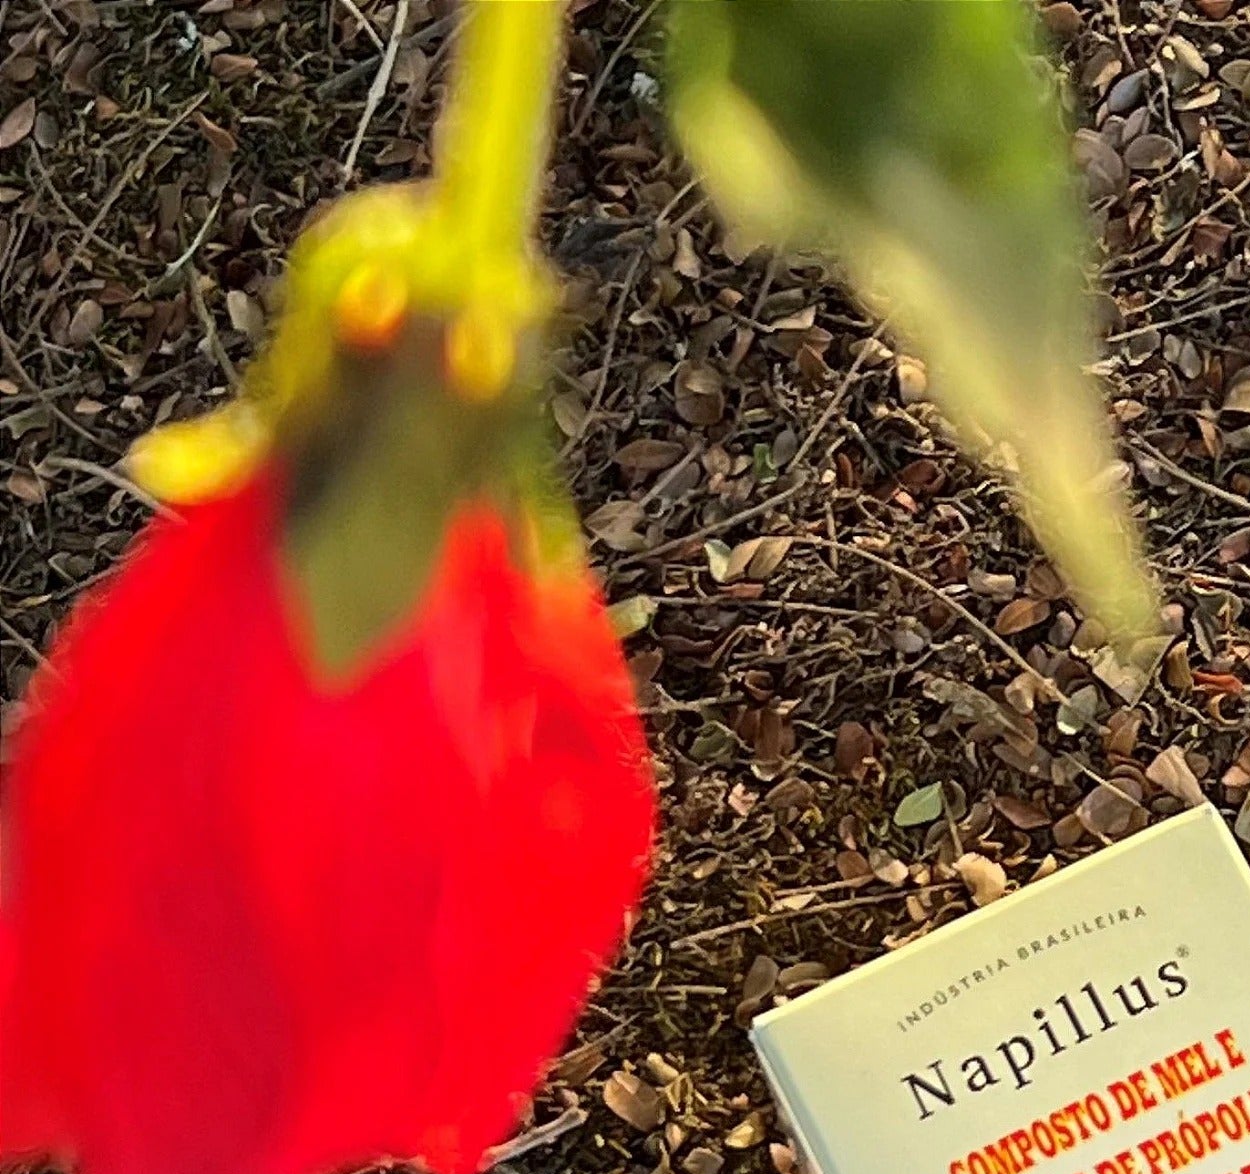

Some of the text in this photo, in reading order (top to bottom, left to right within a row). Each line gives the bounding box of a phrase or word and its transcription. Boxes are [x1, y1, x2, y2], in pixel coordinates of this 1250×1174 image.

[897, 904, 1148, 1033] INDÚSTRIA BRASILEIRA
[1107, 1069, 1157, 1121] DE
[1150, 1041, 1223, 1101] MEL
[1213, 1028, 1246, 1069] E
